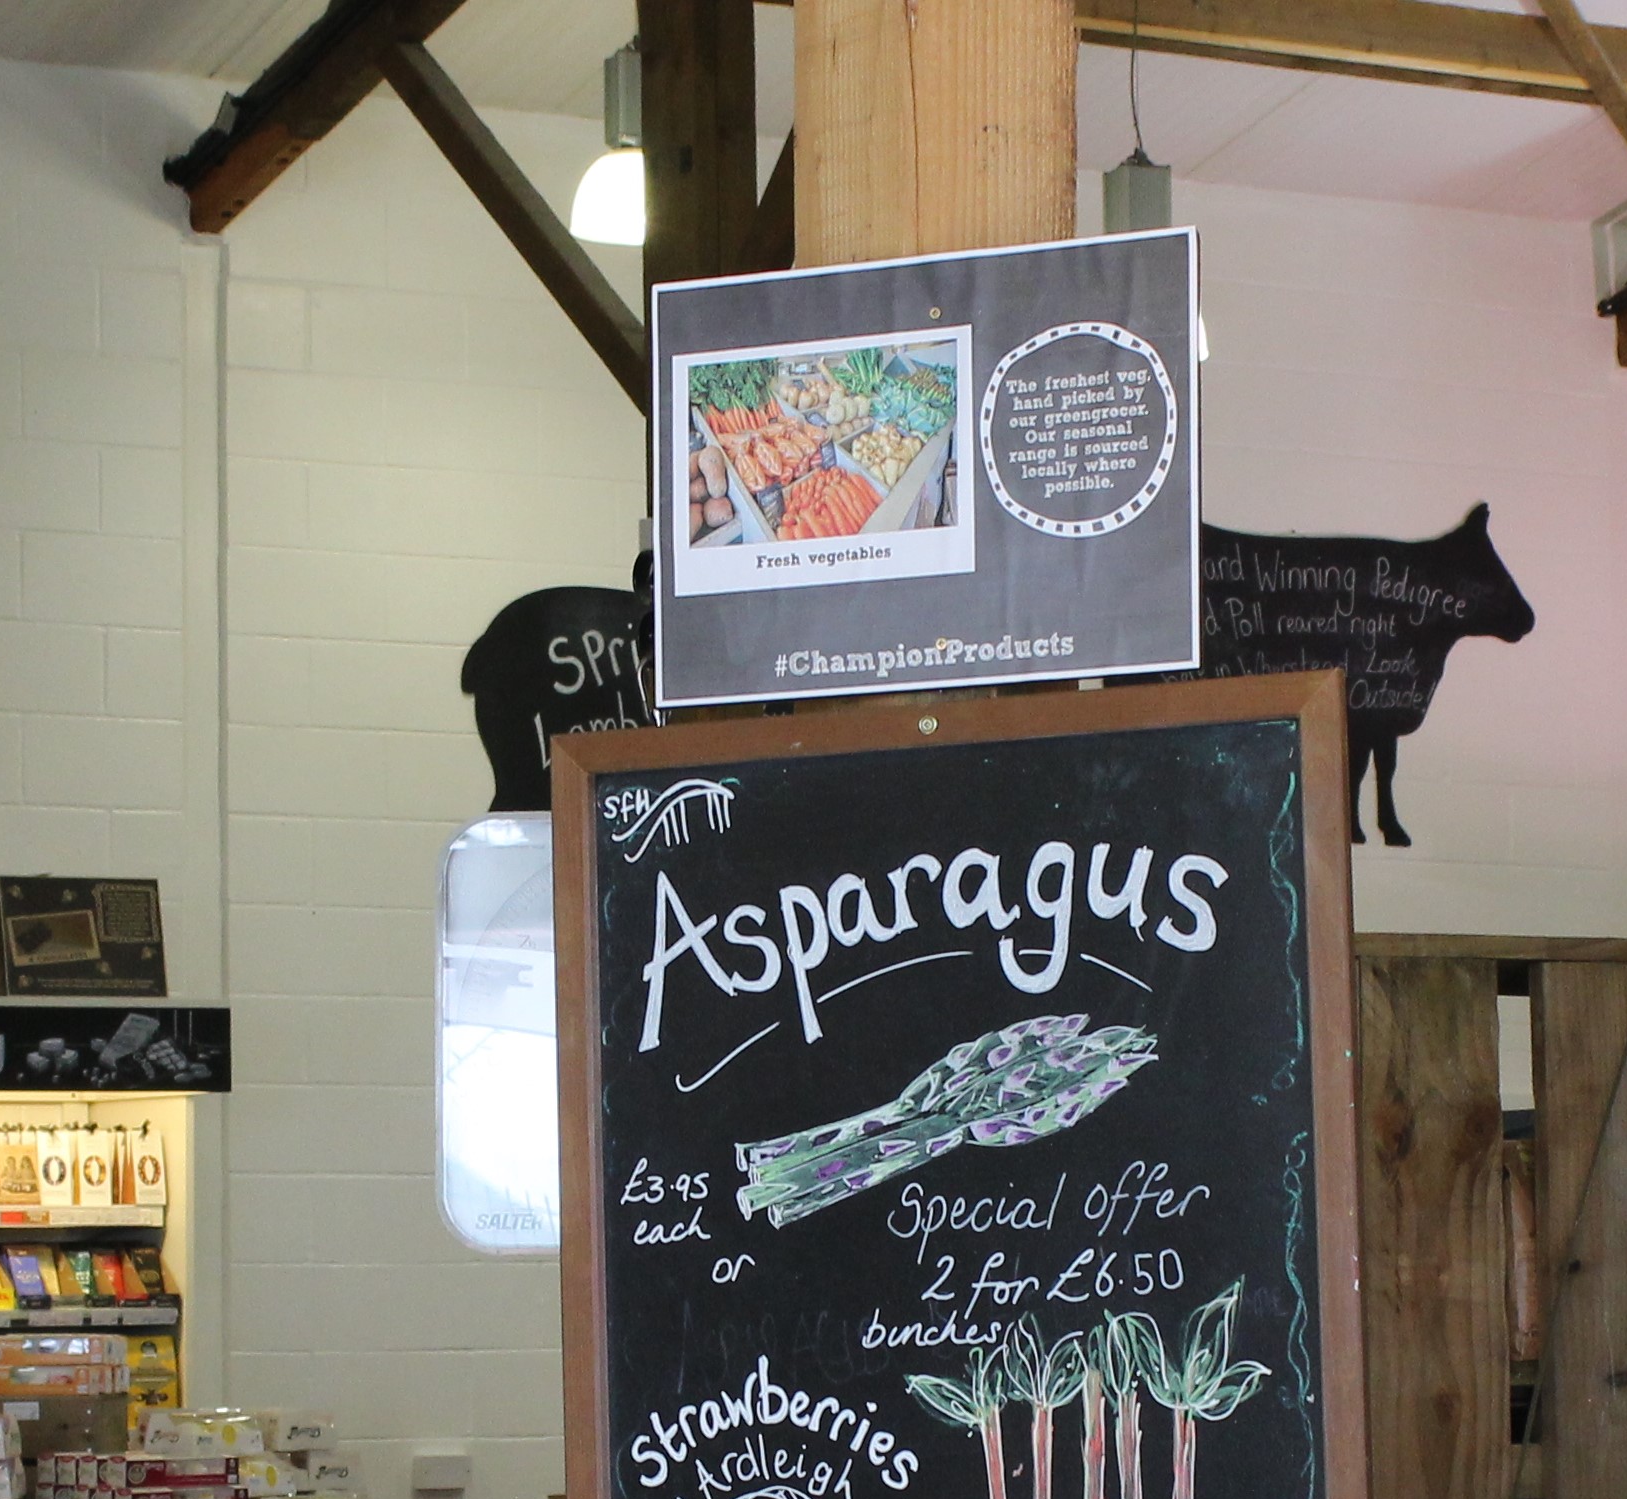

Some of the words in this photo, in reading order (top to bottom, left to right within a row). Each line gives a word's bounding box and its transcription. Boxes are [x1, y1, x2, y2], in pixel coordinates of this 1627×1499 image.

[1006, 379, 1037, 394] The
[1045, 371, 1110, 391] freshest
[1012, 393, 1054, 411] hand
[1061, 387, 1115, 409] picked
[1123, 386, 1145, 403] by
[1009, 415, 1037, 428] our
[1044, 404, 1150, 428] greengrocer.
[1025, 429, 1056, 444] Our
[1063, 421, 1133, 440] seasonal
[1009, 447, 1056, 464] range
[1064, 443, 1078, 458] is
[1085, 436, 1150, 455] sourced
[1021, 461, 1077, 480] locally
[1084, 456, 1136, 472] where
[1044, 475, 1115, 498] possible.
[755, 552, 801, 569] Fresh
[809, 546, 892, 567] vegetables
[1255, 550, 1356, 617] Winning
[1370, 556, 1467, 627] Pedigree
[1225, 597, 1265, 640] Poll
[1277, 605, 1338, 636] reared
[1350, 614, 1397, 650] right
[774, 632, 1074, 678] #ChampionProducts
[638, 840, 1229, 1053] Asparagus
[620, 1157, 710, 1206] £3.95
[633, 1206, 711, 1245] each
[887, 1172, 1068, 1265] Special
[1085, 1160, 1210, 1242] offer
[711, 1254, 756, 1284] or
[921, 1255, 956, 1302] 2
[974, 1256, 1039, 1325] for
[1055, 1247, 1185, 1304] £6.50
[861, 1314, 1008, 1351] bunches
[629, 1355, 920, 1491] Strawberries
